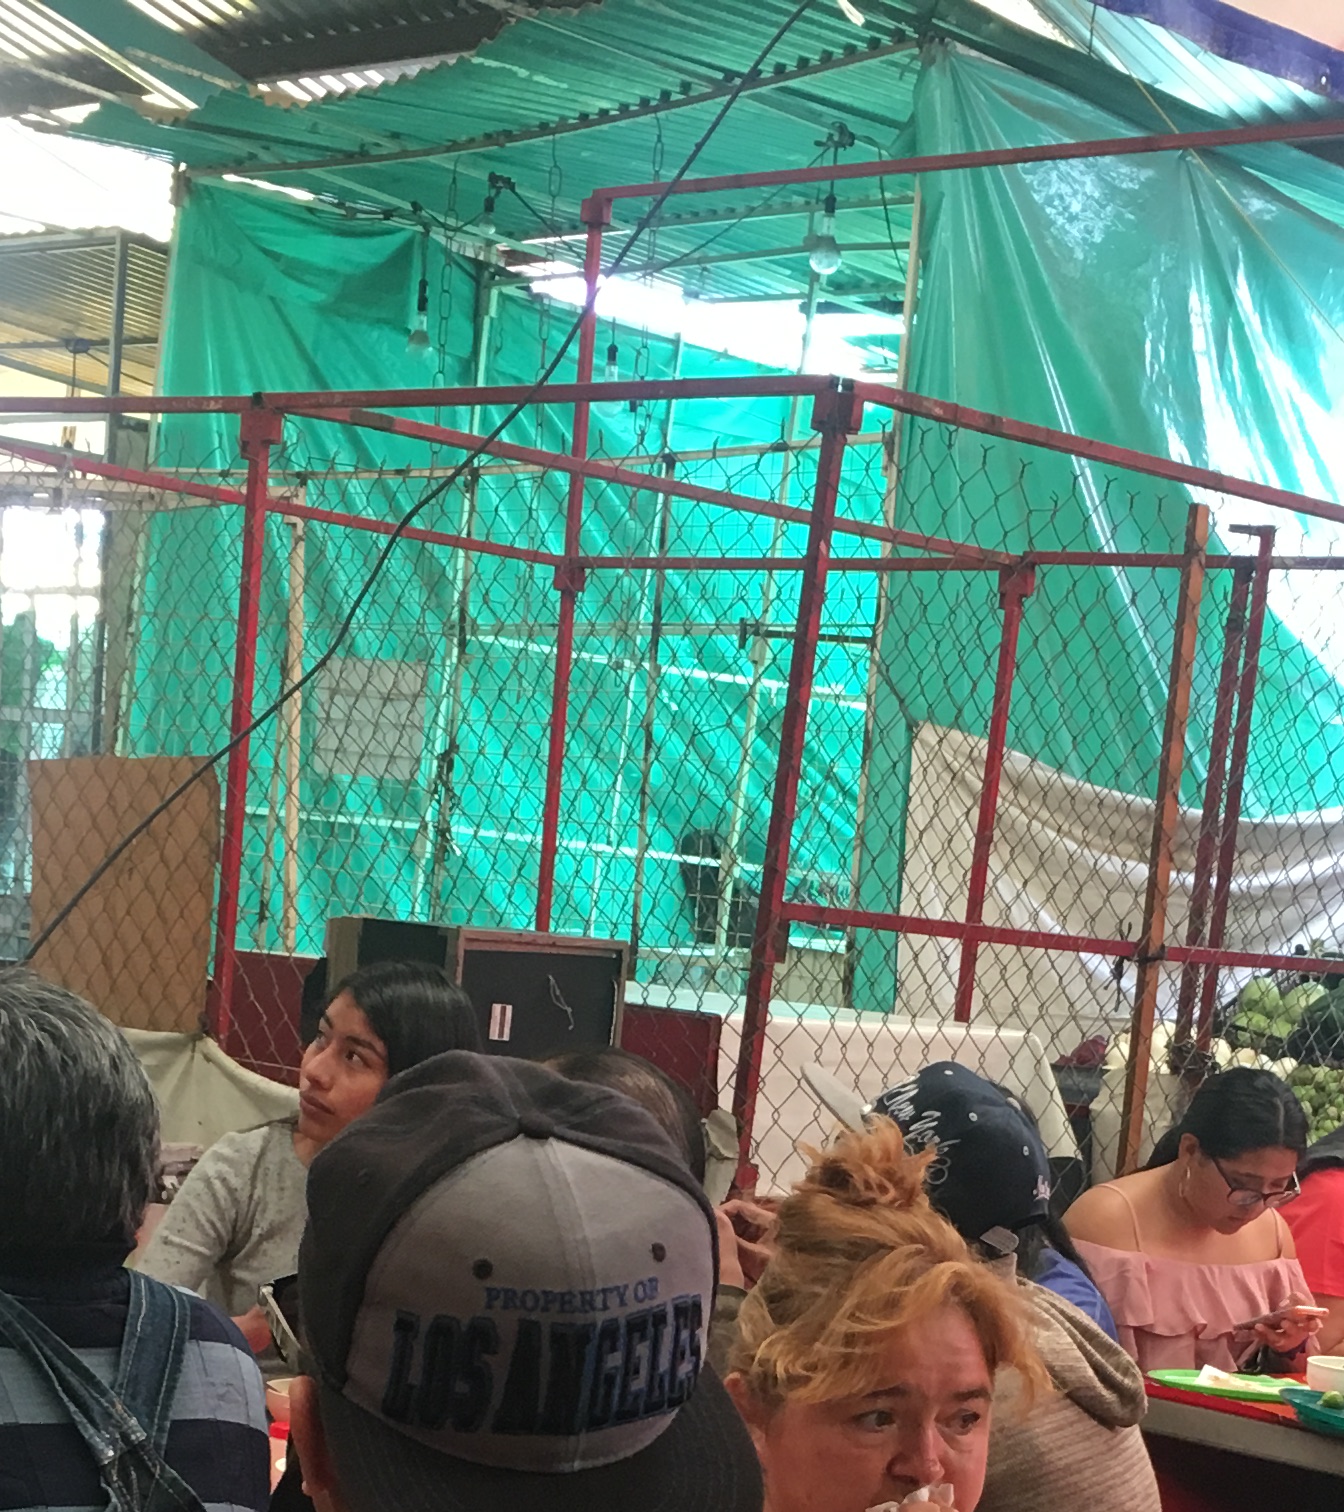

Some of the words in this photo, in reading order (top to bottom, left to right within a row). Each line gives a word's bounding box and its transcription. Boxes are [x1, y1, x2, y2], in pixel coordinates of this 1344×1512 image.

[484, 1283, 629, 1314] PROPERTY
[633, 1276, 659, 1301] OF
[381, 1308, 499, 1432] LOS
[490, 1293, 703, 1436] ANGELES
